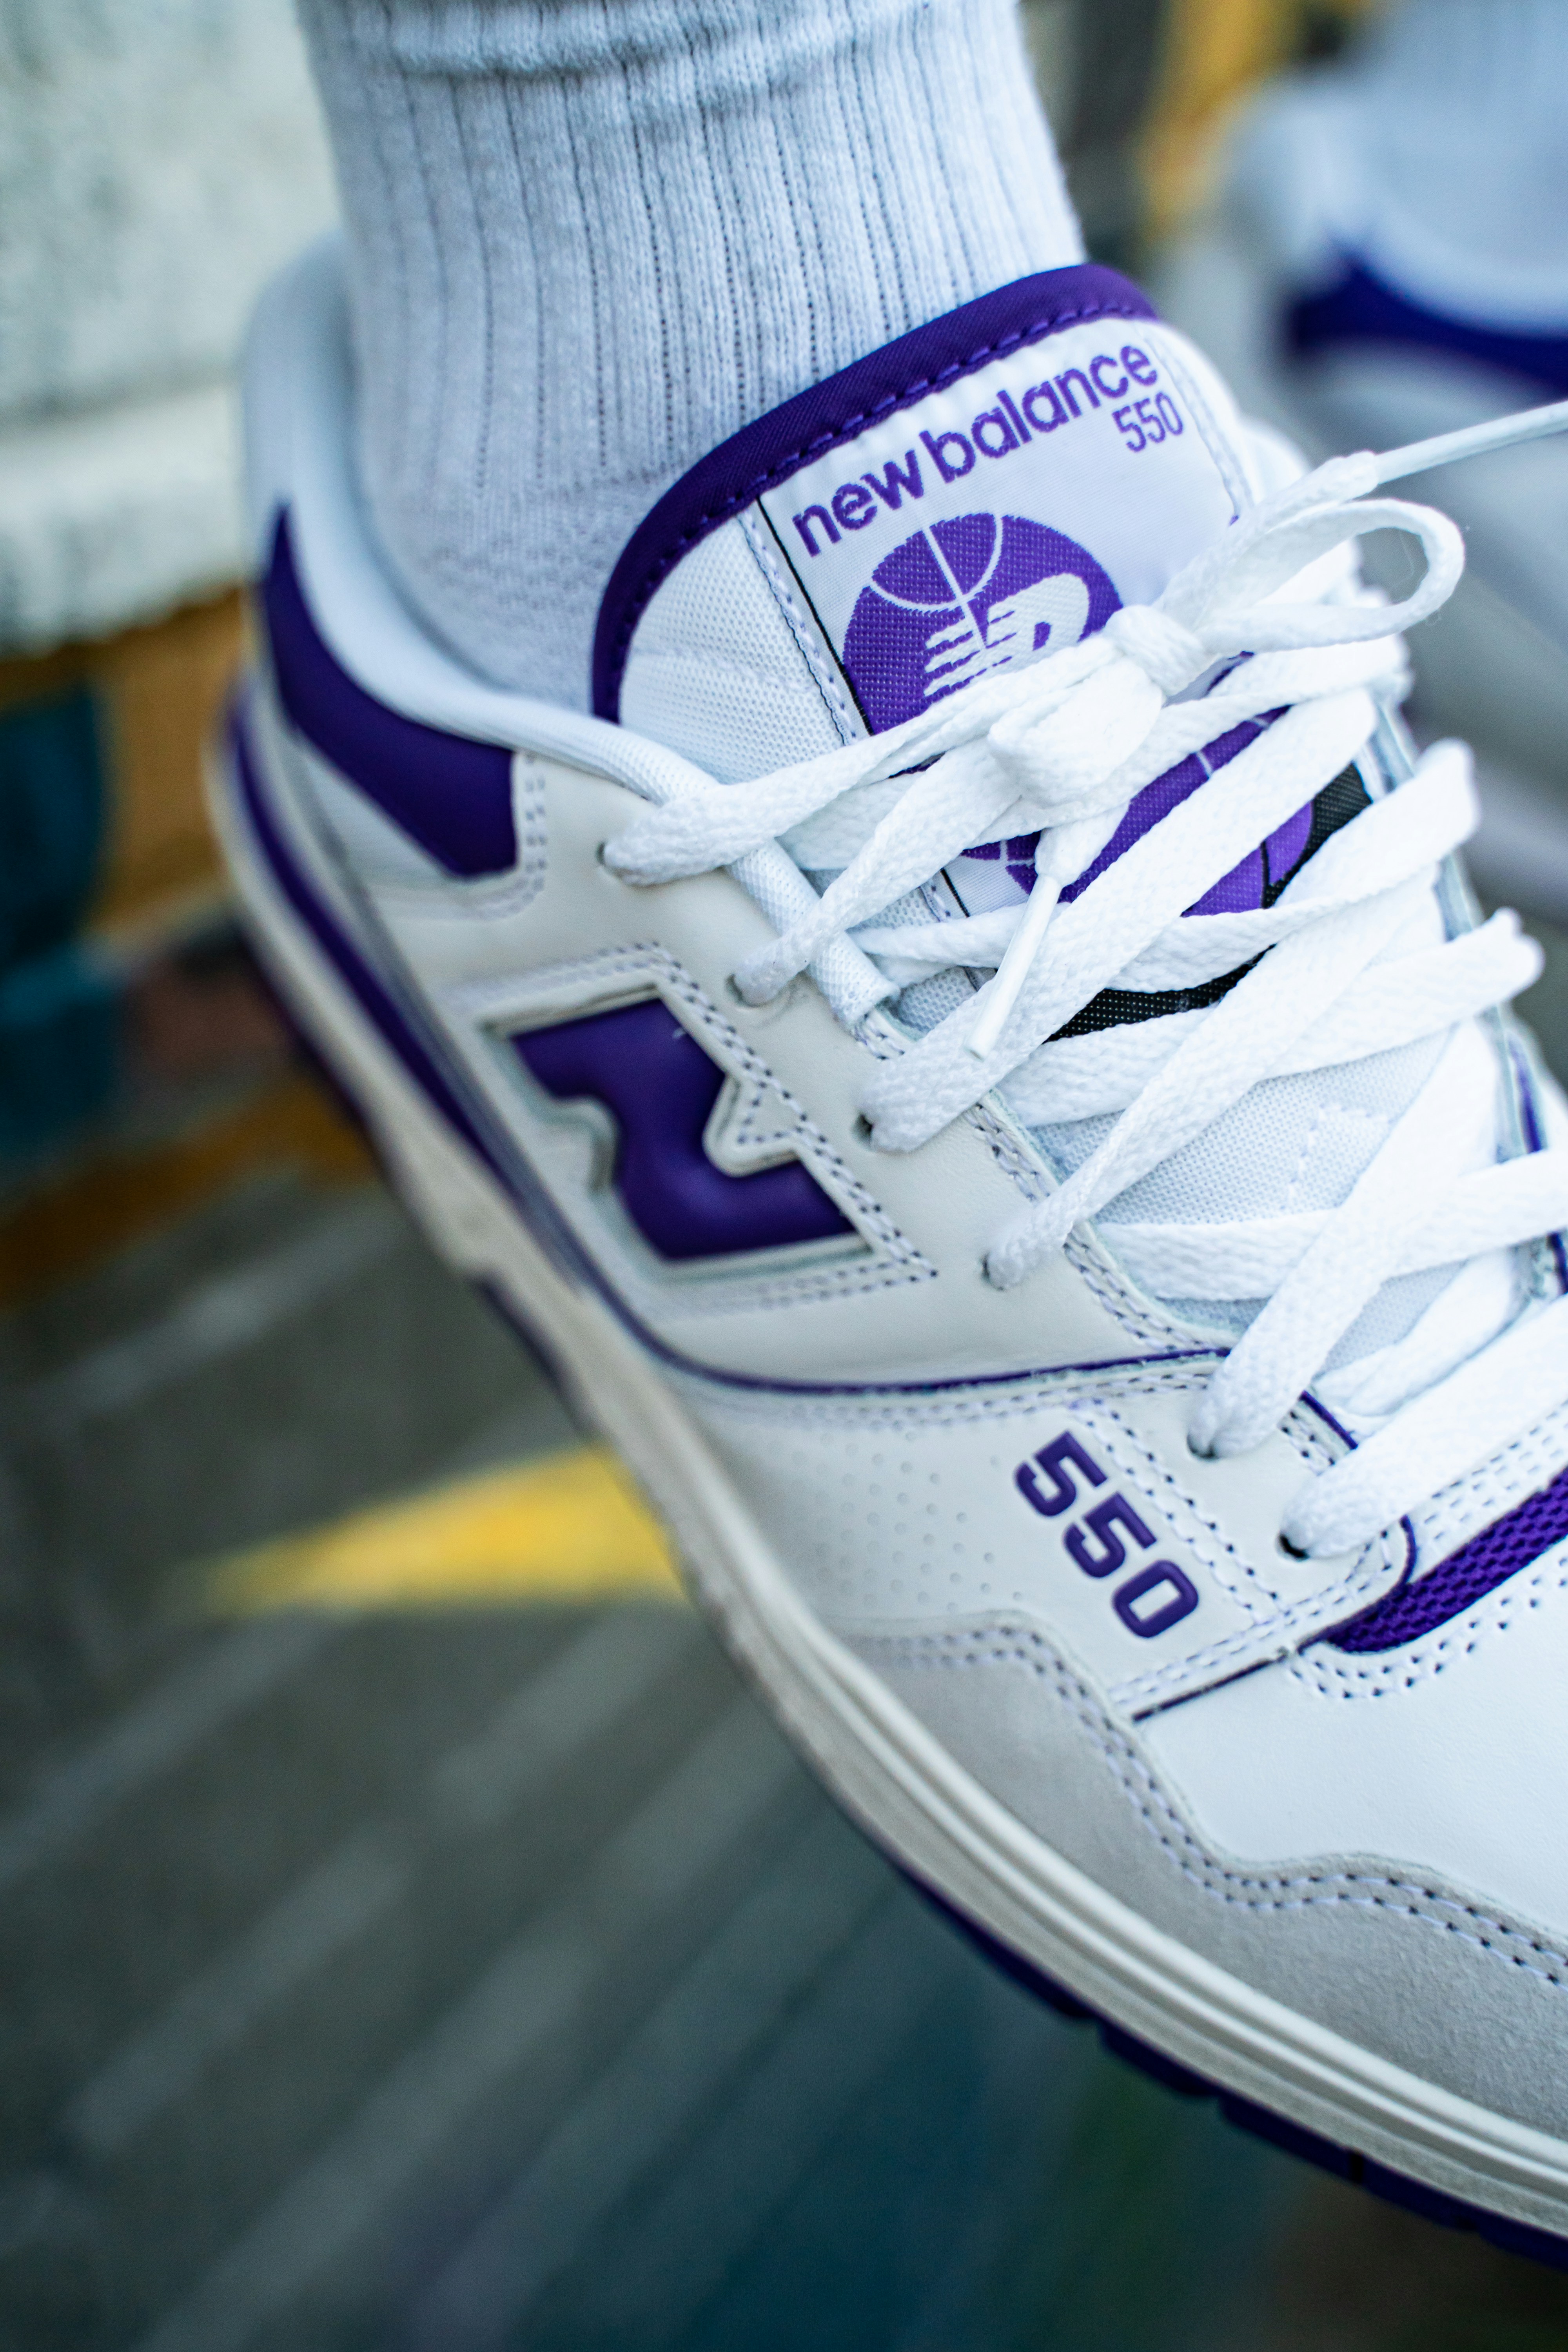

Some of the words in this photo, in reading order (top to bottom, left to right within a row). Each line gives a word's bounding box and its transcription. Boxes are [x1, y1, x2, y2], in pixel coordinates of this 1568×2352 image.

[792, 449, 924, 557] new
[919, 345, 1158, 483] balance
[1112, 392, 1184, 452] 550
[1013, 1429, 1200, 1639] 550
